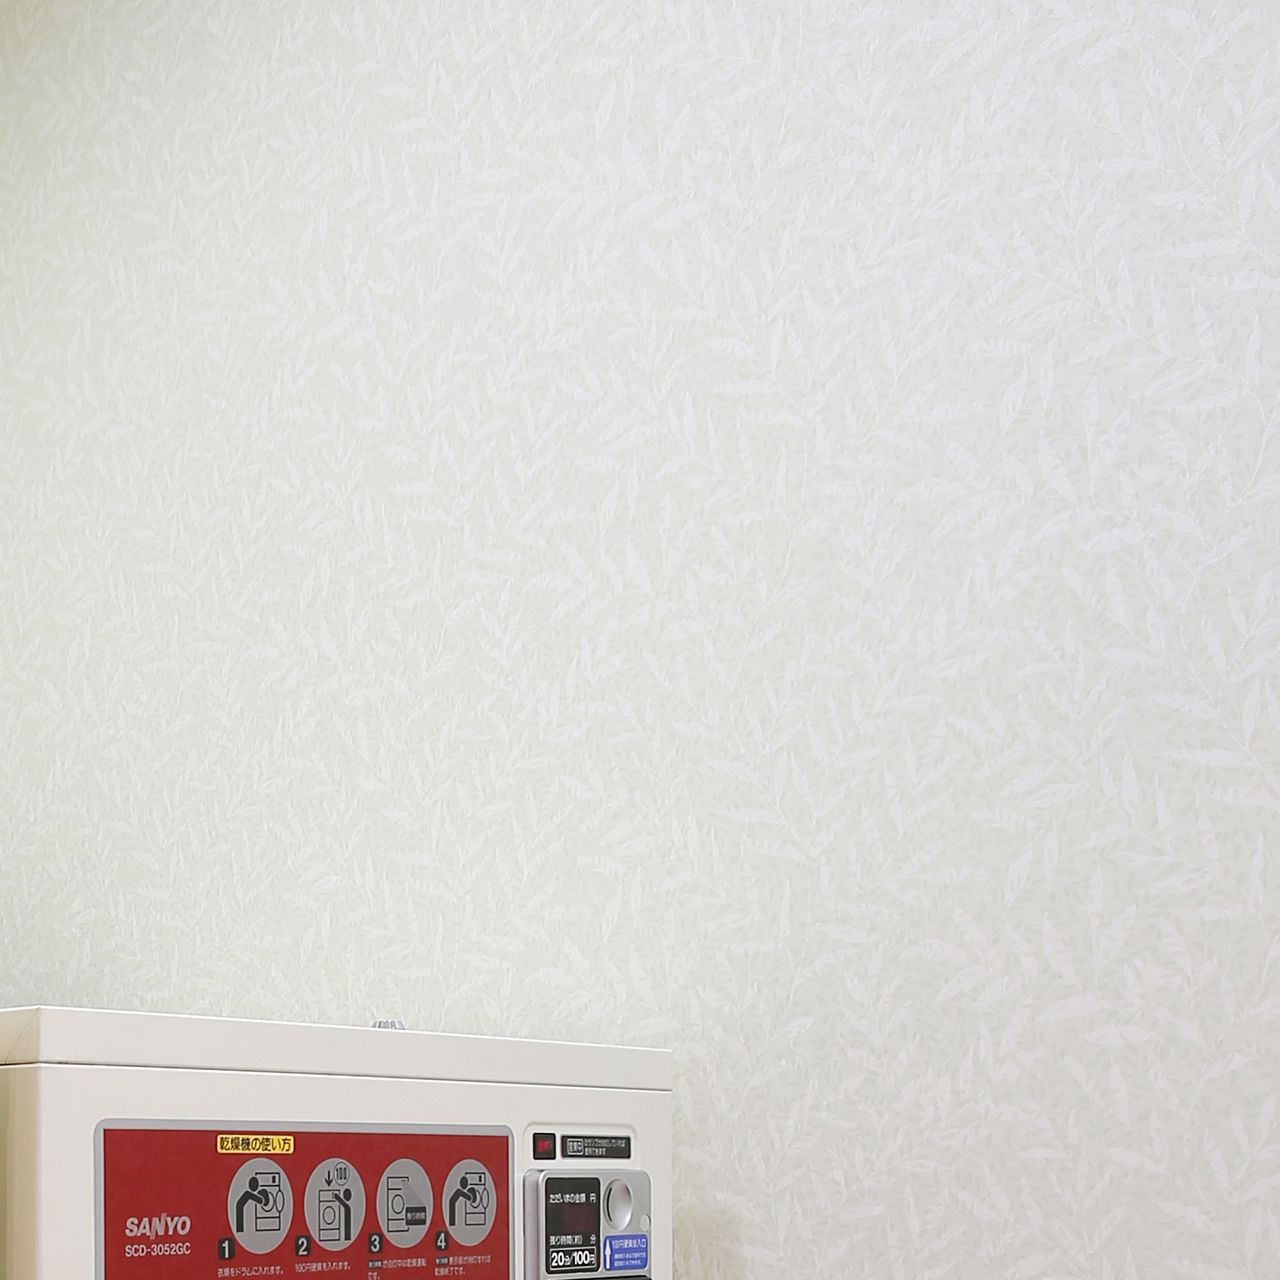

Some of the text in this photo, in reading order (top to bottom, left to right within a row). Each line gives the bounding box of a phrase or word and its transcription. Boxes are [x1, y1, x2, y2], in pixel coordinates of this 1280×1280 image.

[220, 1136, 291, 1152] 乾燥機の使い方
[336, 1168, 347, 1180] 100
[125, 1213, 191, 1239] SANYO
[222, 1240, 230, 1258] 1
[298, 1238, 308, 1255] 2
[371, 1235, 379, 1252] 3
[437, 1233, 445, 1249] 4
[125, 1243, 191, 1257] SCD-3052GC
